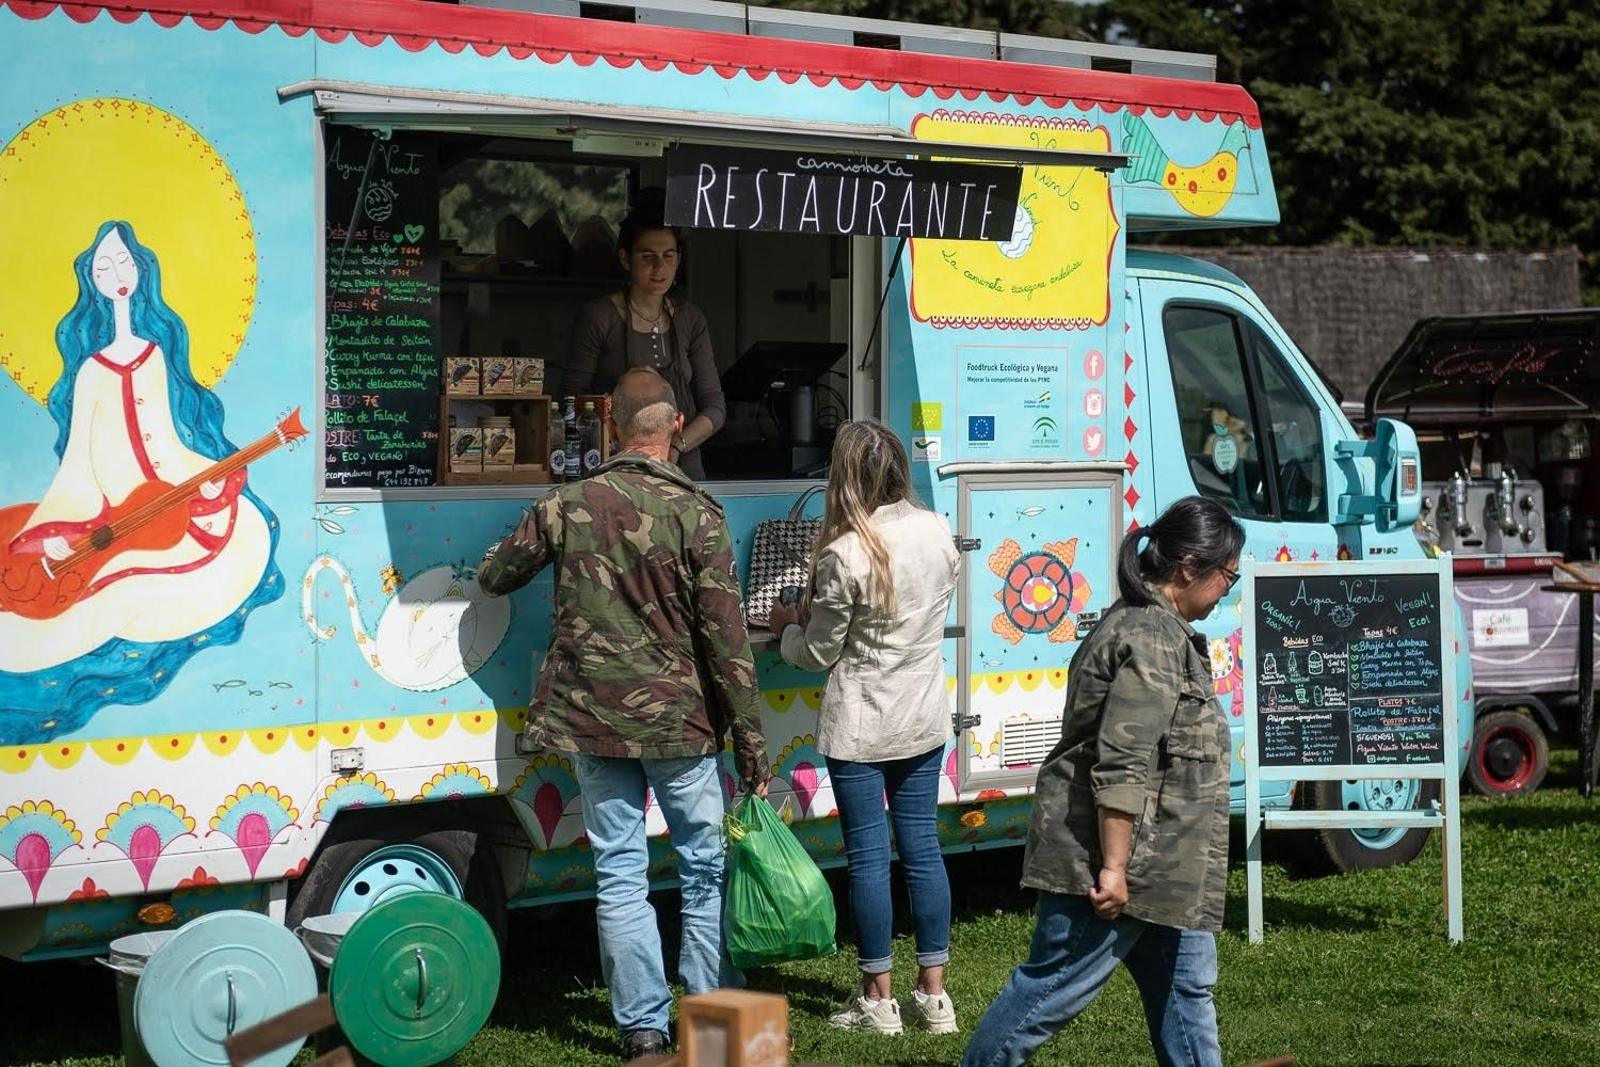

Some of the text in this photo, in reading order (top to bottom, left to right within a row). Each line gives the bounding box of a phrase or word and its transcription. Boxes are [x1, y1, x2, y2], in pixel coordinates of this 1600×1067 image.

[694, 163, 997, 240] RESTAURANTE
[362, 298, 379, 311] 4€
[371, 315, 383, 326] de
[383, 335, 395, 346] de
[397, 353, 412, 362] con
[331, 364, 438, 380] Empanada con Algas
[966, 362, 998, 372] Foodtruck
[1000, 363, 1030, 374] Ecológica
[1036, 364, 1059, 374] Vegana
[329, 377, 363, 391] Sushi
[325, 394, 380, 408] LATO: 7€
[357, 410, 370, 423] de
[325, 430, 362, 444] OSTRE:
[392, 431, 404, 440] de
[341, 451, 360, 462] ECO
[1290, 579, 1337, 616] Agua
[1340, 579, 1389, 604] Viento
[1489, 613, 1511, 625] Café
[1362, 626, 1398, 639] Tapas 4€
[1386, 640, 1395, 648] de
[1361, 670, 1404, 680] Empanada
[1404, 697, 1417, 705] 7€
[1350, 706, 1386, 717] Rollito
[1390, 707, 1402, 716] de
[1356, 743, 1377, 756] Agua
[1420, 742, 1439, 750] Wind
